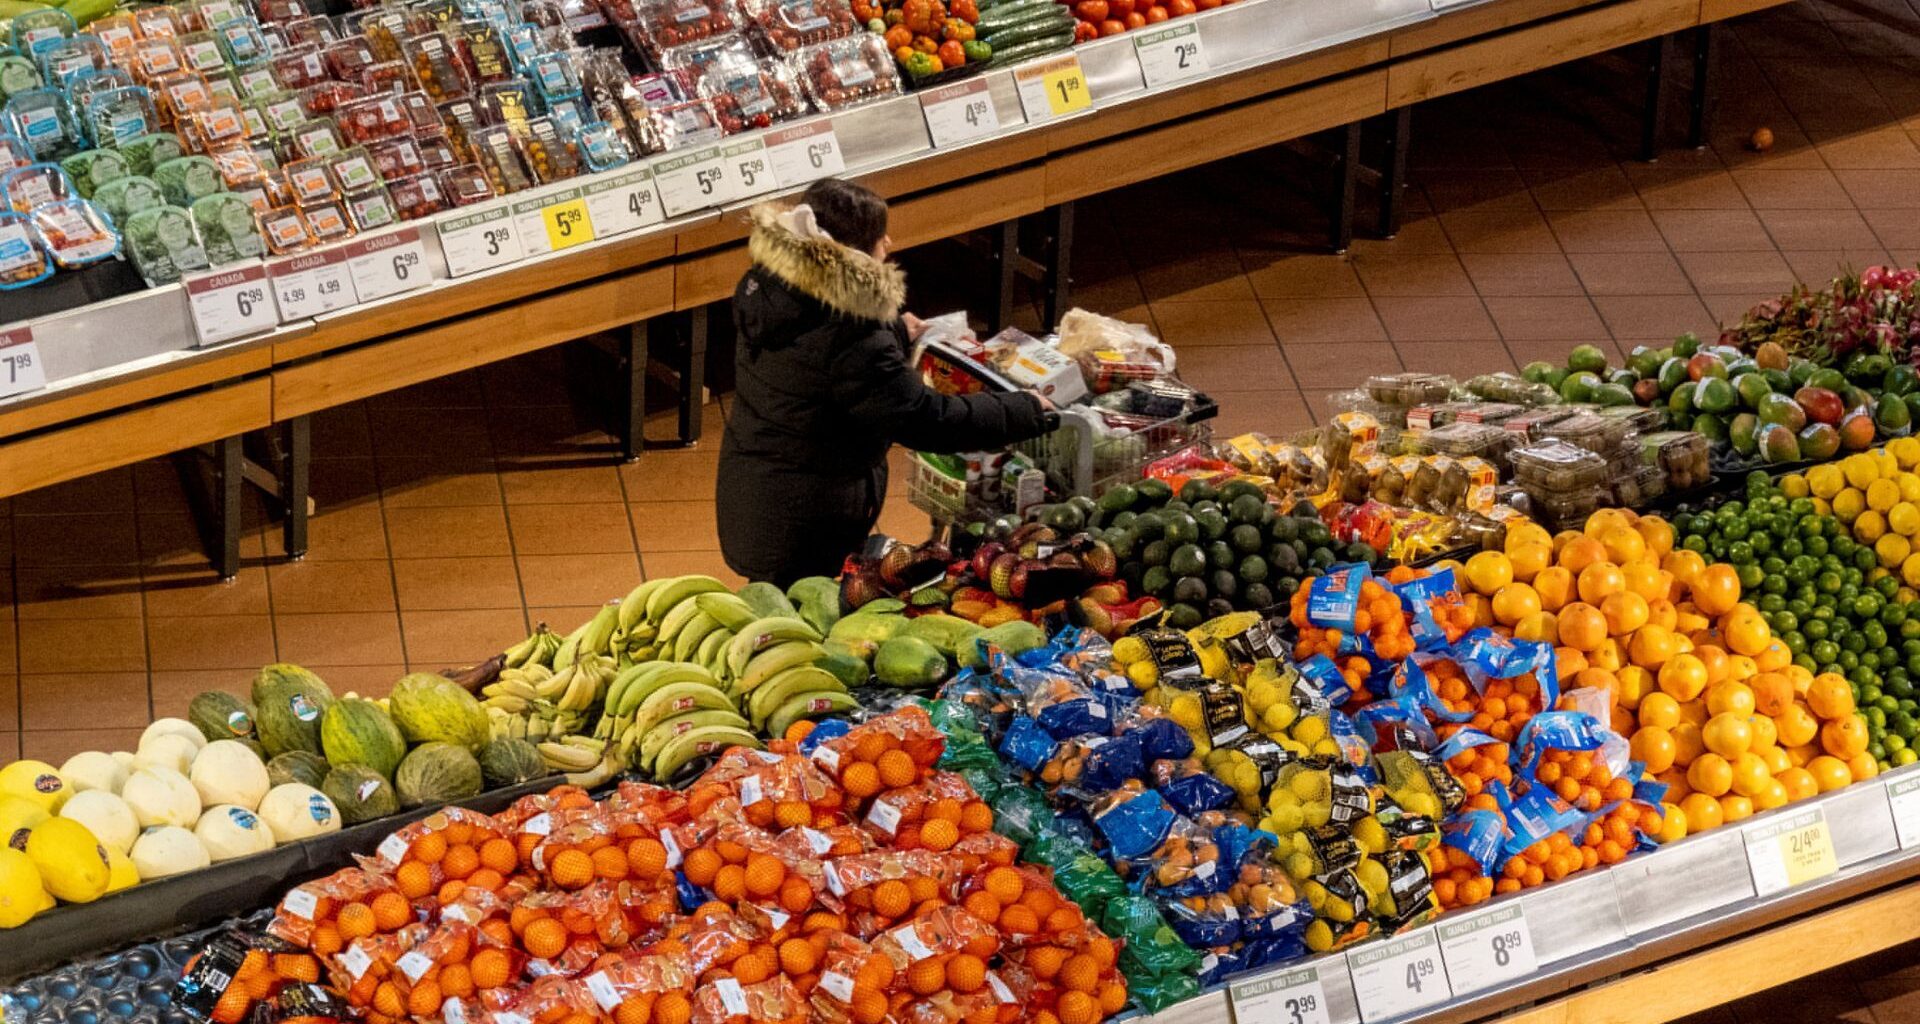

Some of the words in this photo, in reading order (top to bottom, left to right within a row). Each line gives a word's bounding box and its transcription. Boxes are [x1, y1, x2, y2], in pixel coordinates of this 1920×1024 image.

[939, 86, 970, 99] CANADA
[782, 126, 815, 140] CANADA
[364, 234, 401, 251] CANADA
[291, 254, 327, 271] CANADA
[209, 271, 246, 288] CANADA
[318, 279, 341, 296] 4.99
[1447, 919, 1476, 936] QUALITY
[1477, 915, 1492, 926] YOU
[1492, 907, 1515, 922] TRUST
[1357, 948, 1387, 965] QUALITY
[1389, 943, 1404, 955] YOU
[1404, 935, 1426, 951] TRUST
[1240, 980, 1270, 998] QUALITY
[1271, 976, 1287, 988] YOU
[1287, 971, 1310, 985] TRUST
